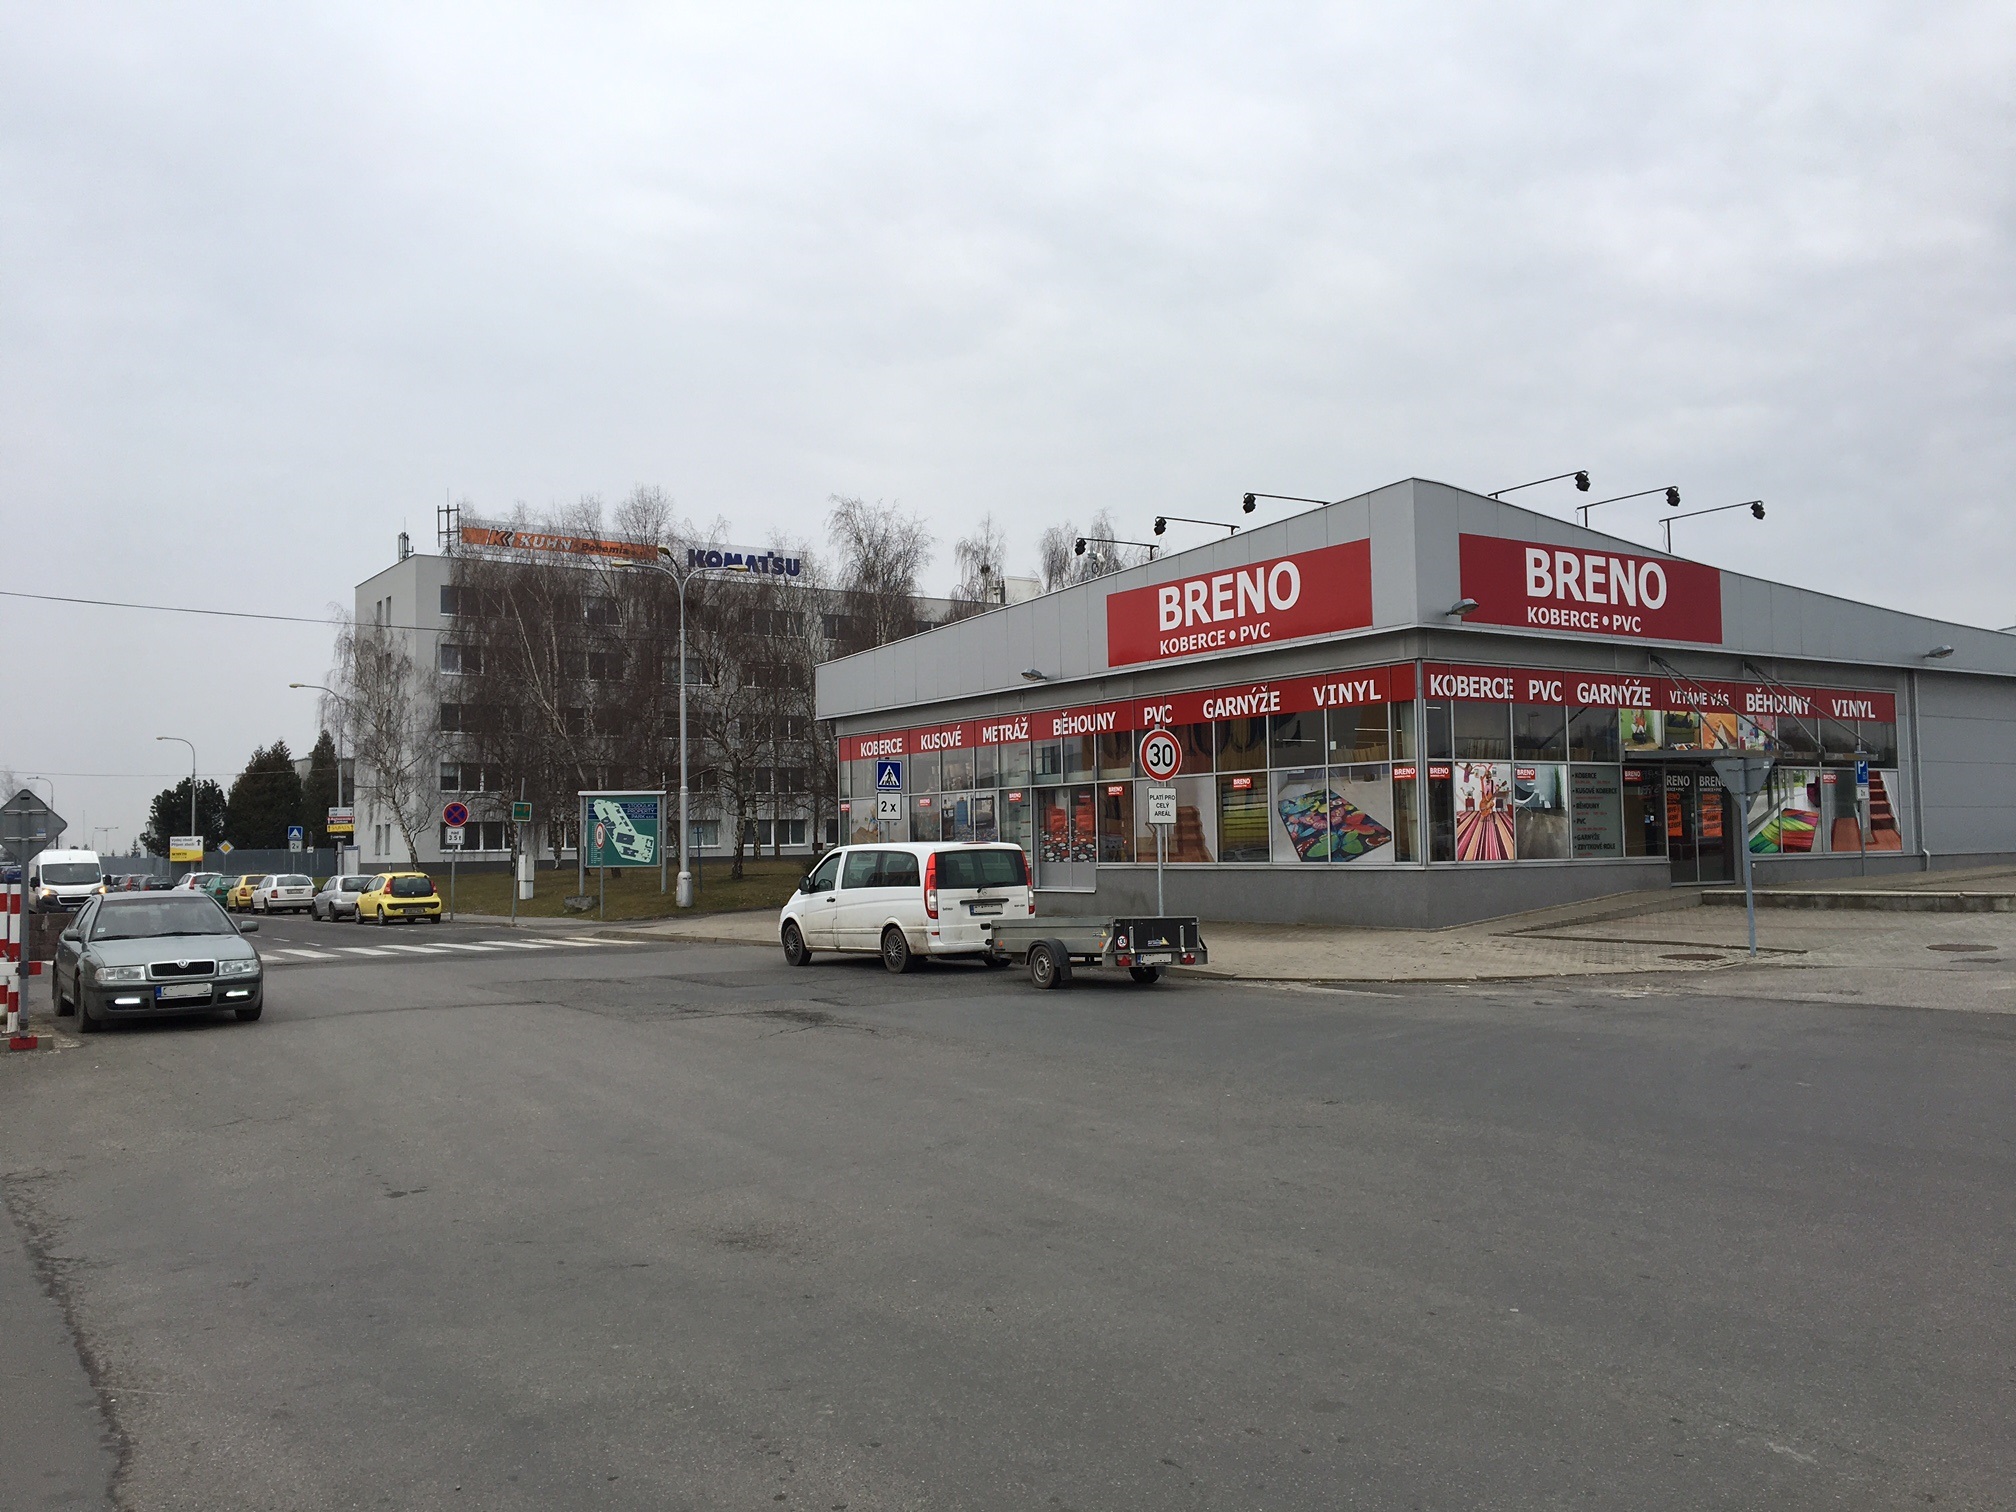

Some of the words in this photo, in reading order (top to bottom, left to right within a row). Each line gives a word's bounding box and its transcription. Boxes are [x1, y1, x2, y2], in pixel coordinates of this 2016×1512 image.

[519, 535, 573, 550] KUHN
[687, 548, 801, 577] KOMATSU
[1525, 547, 1667, 610] BRENO
[1158, 560, 1301, 632] BRENO
[1527, 606, 1599, 629] KOBERCE
[1613, 614, 1642, 633] PVC
[1159, 629, 1226, 656] KOBERCE
[1240, 622, 1271, 642] PVC
[1430, 674, 1514, 699] KOBERCE
[1528, 679, 1562, 702] PVC
[1576, 678, 1652, 707] GARNÝŽE
[1669, 687, 1708, 706] VÍTÁME
[1710, 689, 1730, 706] VÁS
[1746, 687, 1811, 715] BĚHOUNY
[1832, 699, 1876, 719] VINYL
[860, 737, 903, 757] KOBERCE
[920, 725, 962, 750] KUSOVÉ
[982, 717, 1029, 743] METRÁŽ
[1053, 711, 1117, 736] BĚHOUNY
[1144, 705, 1173, 725] PVC
[1203, 685, 1281, 720] GARNÝŽE
[1313, 679, 1382, 707] VINYL
[1149, 742, 1174, 768] 30
[1394, 767, 1416, 776] BRENO
[1430, 767, 1449, 775] BRENO
[1517, 768, 1535, 776] BRENO
[1666, 775, 1690, 787] RENO
[880, 800, 888, 813] 2
[1154, 809, 1172, 817] AREÁL
